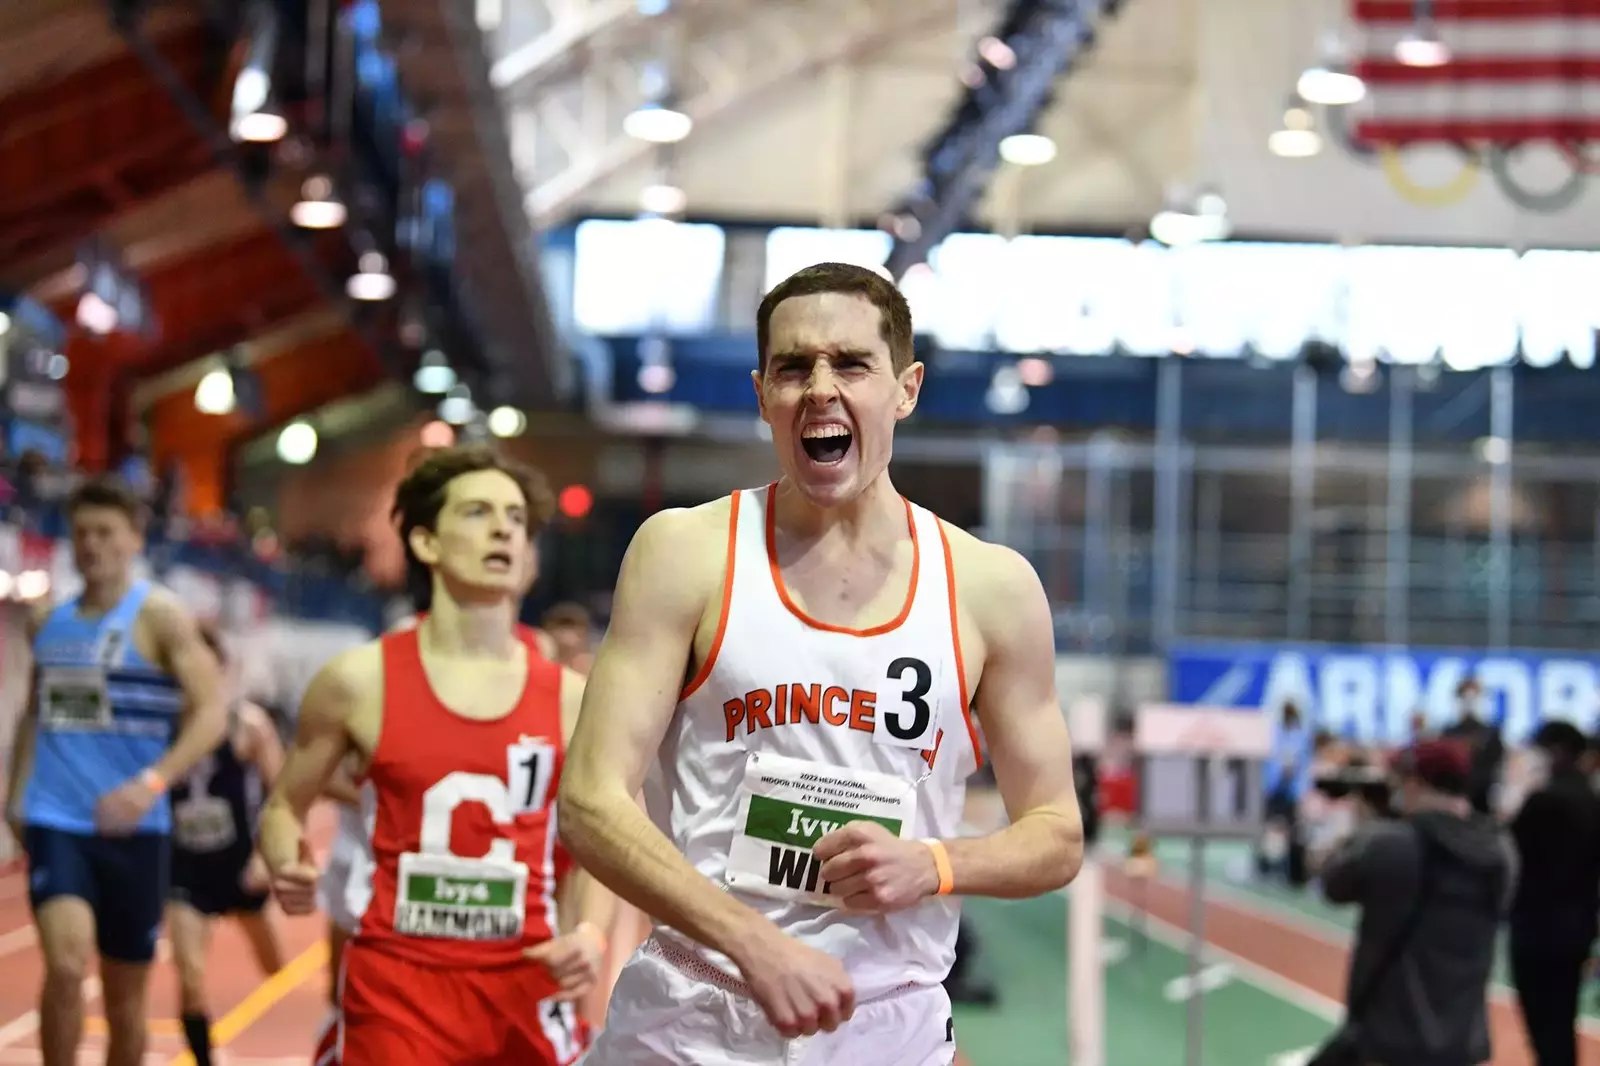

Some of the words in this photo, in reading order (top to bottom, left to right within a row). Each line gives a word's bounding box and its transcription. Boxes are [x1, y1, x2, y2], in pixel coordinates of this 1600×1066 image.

[884, 657, 932, 740] 3
[520, 752, 538, 807] 1
[760, 776, 790, 788] INDOOR
[792, 782, 816, 791] TRACK
[823, 788, 844, 797] FIELD
[845, 791, 901, 805] CHAMPIONSHIPS
[800, 773, 818, 782] 2022
[819, 776, 866, 790] HEPTAGONAL
[801, 794, 812, 802] AT
[814, 796, 827, 804] THE
[828, 799, 860, 810] ARMORY
[420, 771, 516, 857] C
[768, 845, 831, 894] WI
